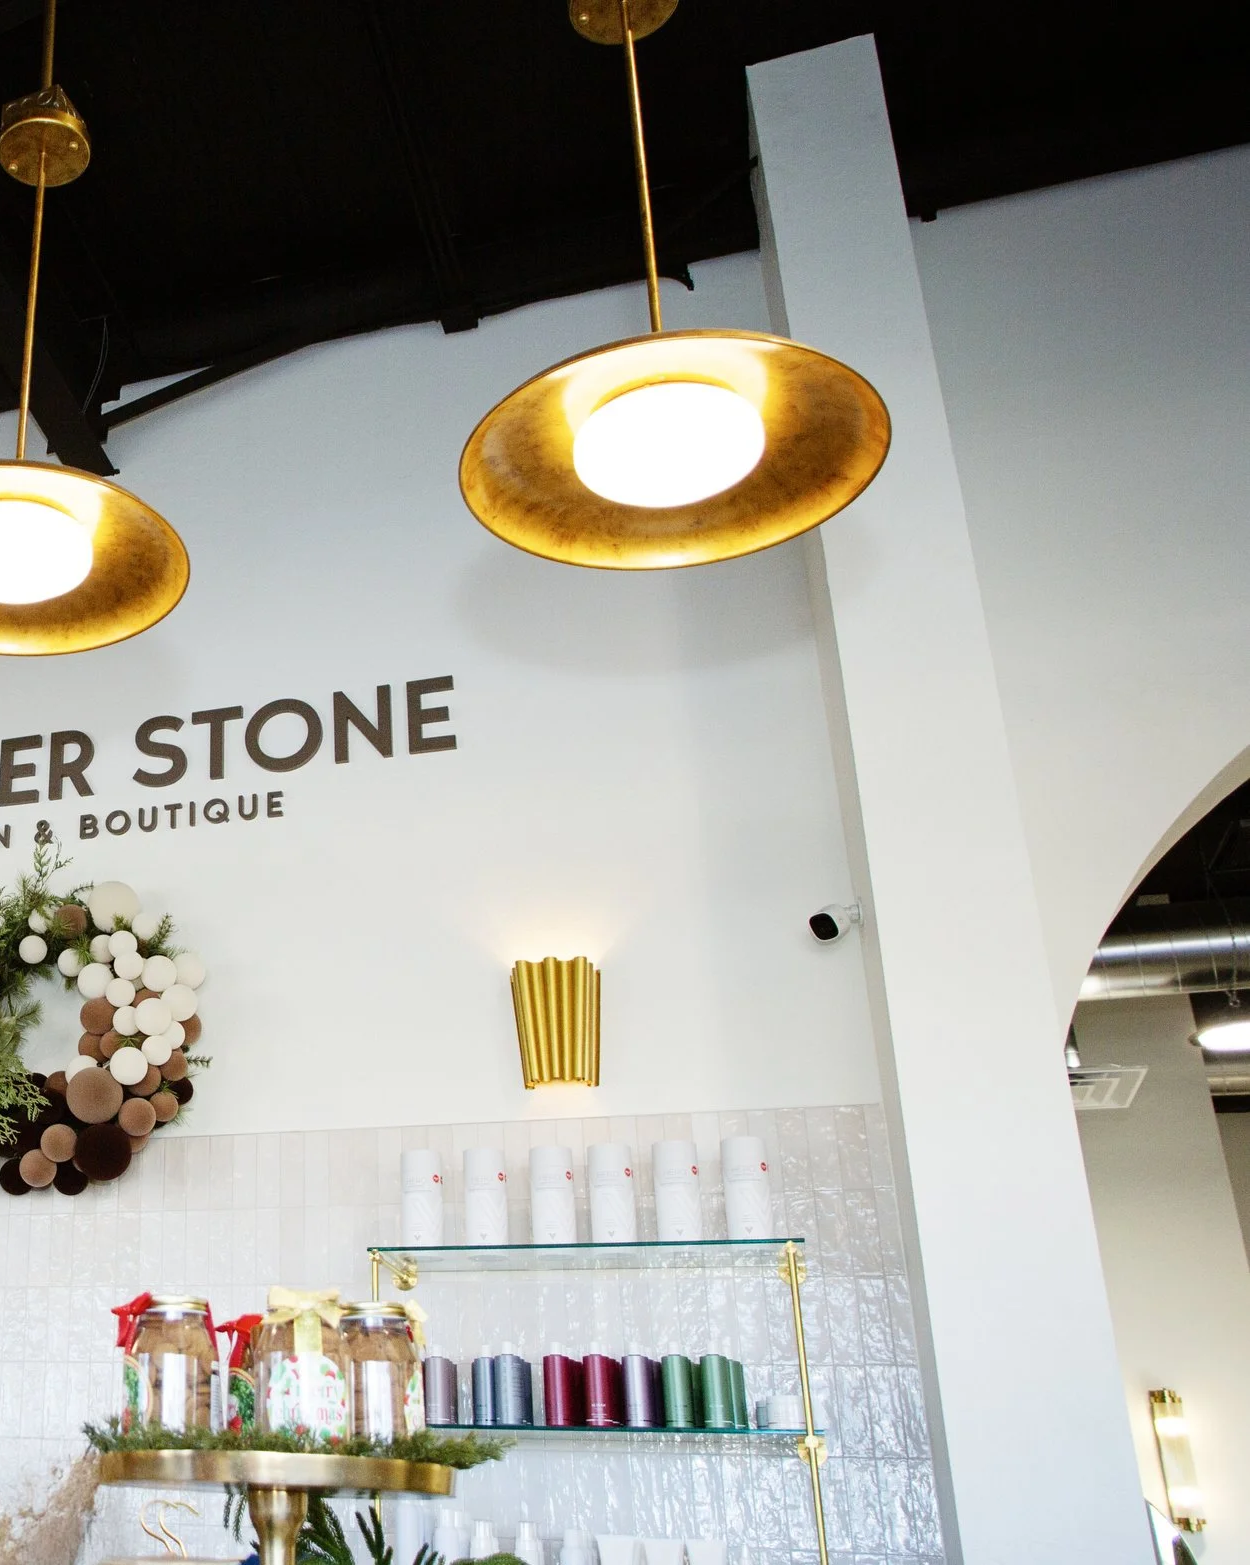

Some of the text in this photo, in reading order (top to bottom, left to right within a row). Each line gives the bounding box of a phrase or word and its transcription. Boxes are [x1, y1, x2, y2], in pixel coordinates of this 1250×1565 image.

[133, 675, 458, 788] STONE
[34, 819, 54, 847] &
[80, 791, 285, 840] BOUTIQUE
